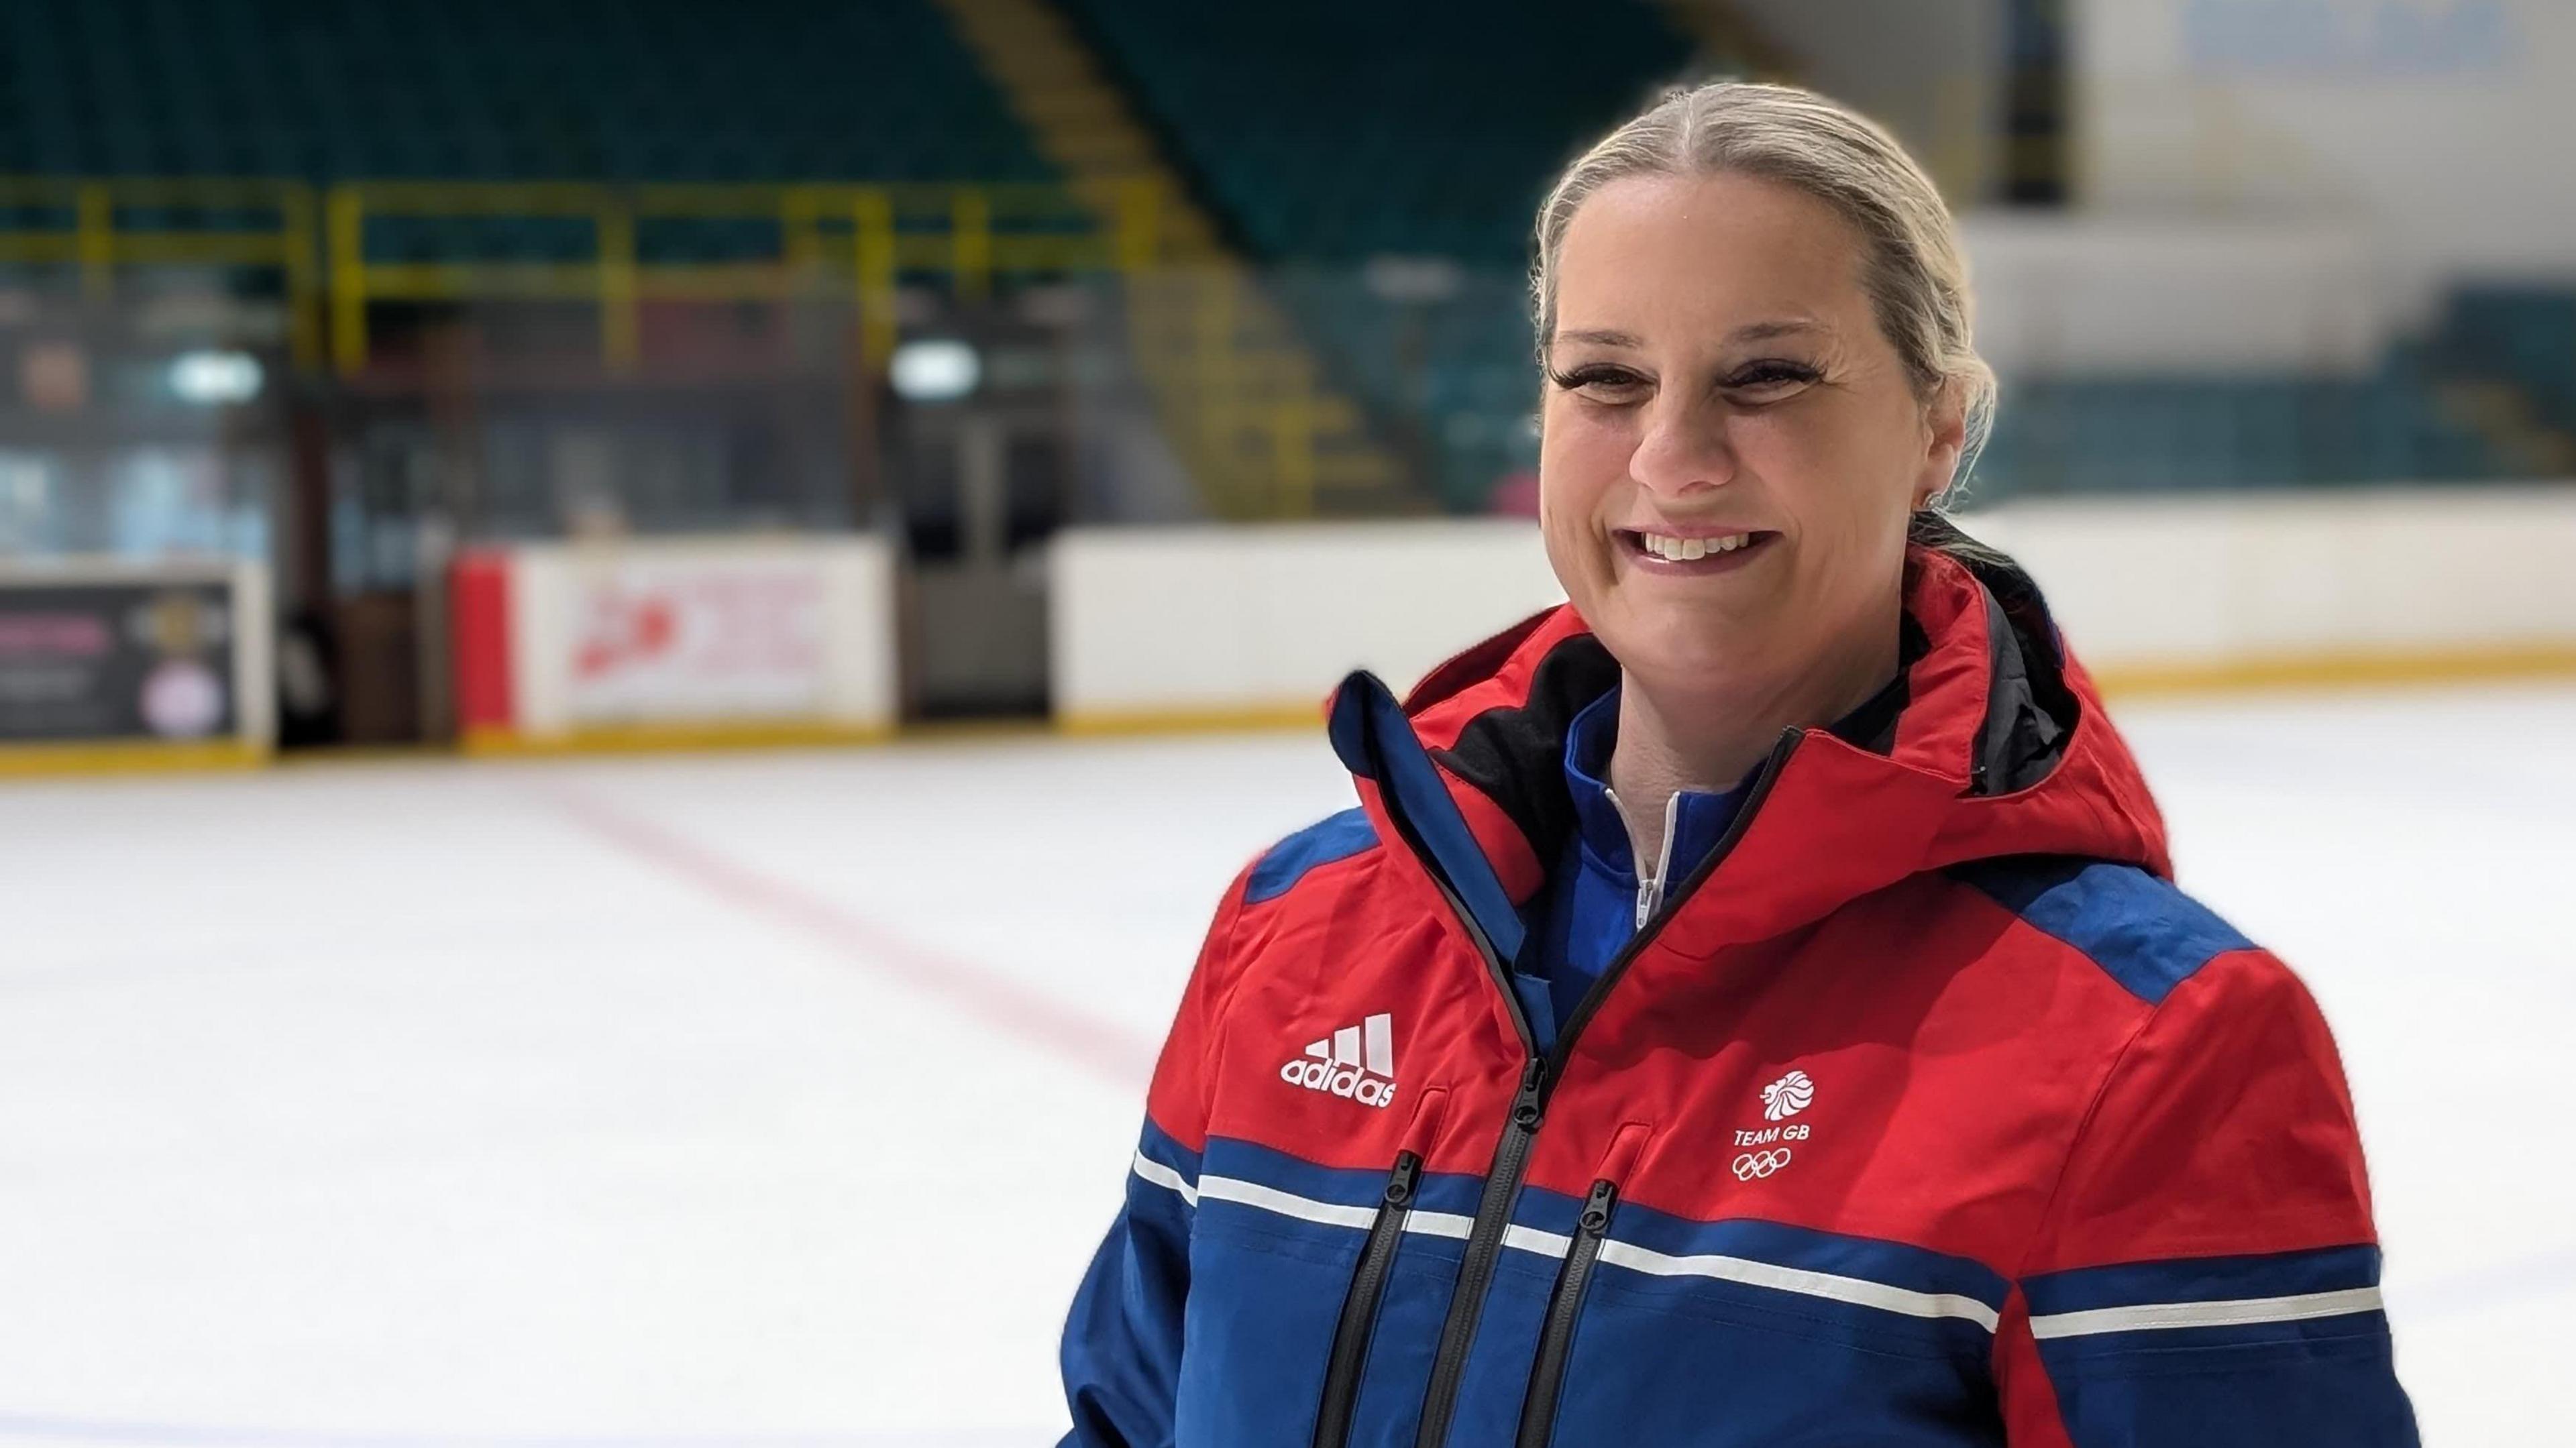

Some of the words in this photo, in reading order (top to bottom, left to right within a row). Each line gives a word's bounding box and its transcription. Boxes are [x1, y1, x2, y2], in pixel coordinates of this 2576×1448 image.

[1281, 1058, 1397, 1108] adidas
[1734, 1127, 1780, 1146] TEAM
[1782, 1125, 1810, 1140] GB
